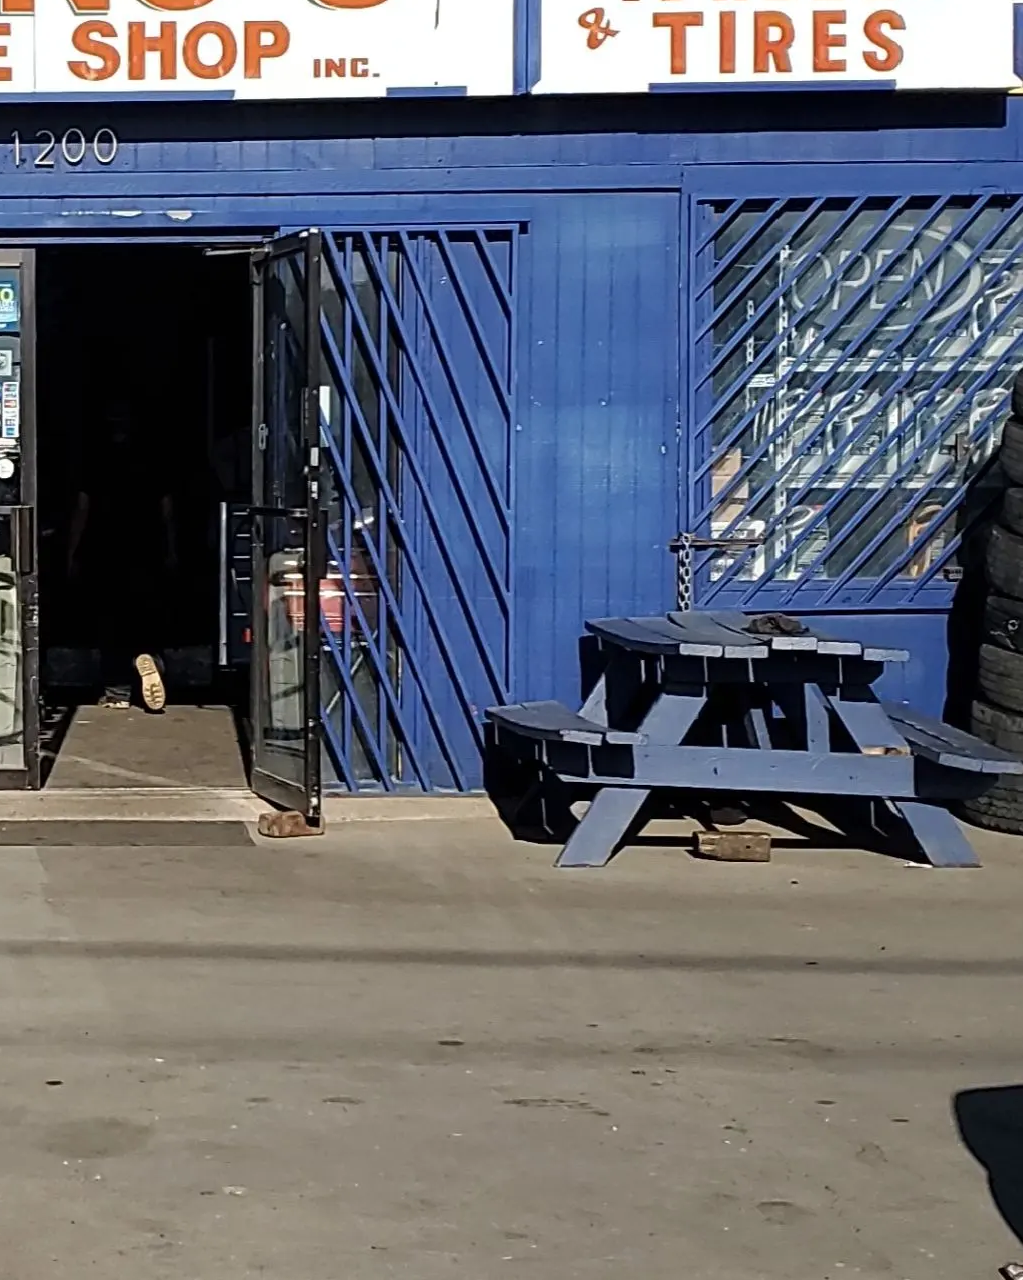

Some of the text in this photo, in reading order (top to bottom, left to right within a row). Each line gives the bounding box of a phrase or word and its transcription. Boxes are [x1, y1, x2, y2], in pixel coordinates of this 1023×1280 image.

[66, 19, 291, 82] SHOP
[313, 57, 380, 79] INC.
[577, 7, 907, 75] & TIRES
[10, 128, 117, 167] 1200
